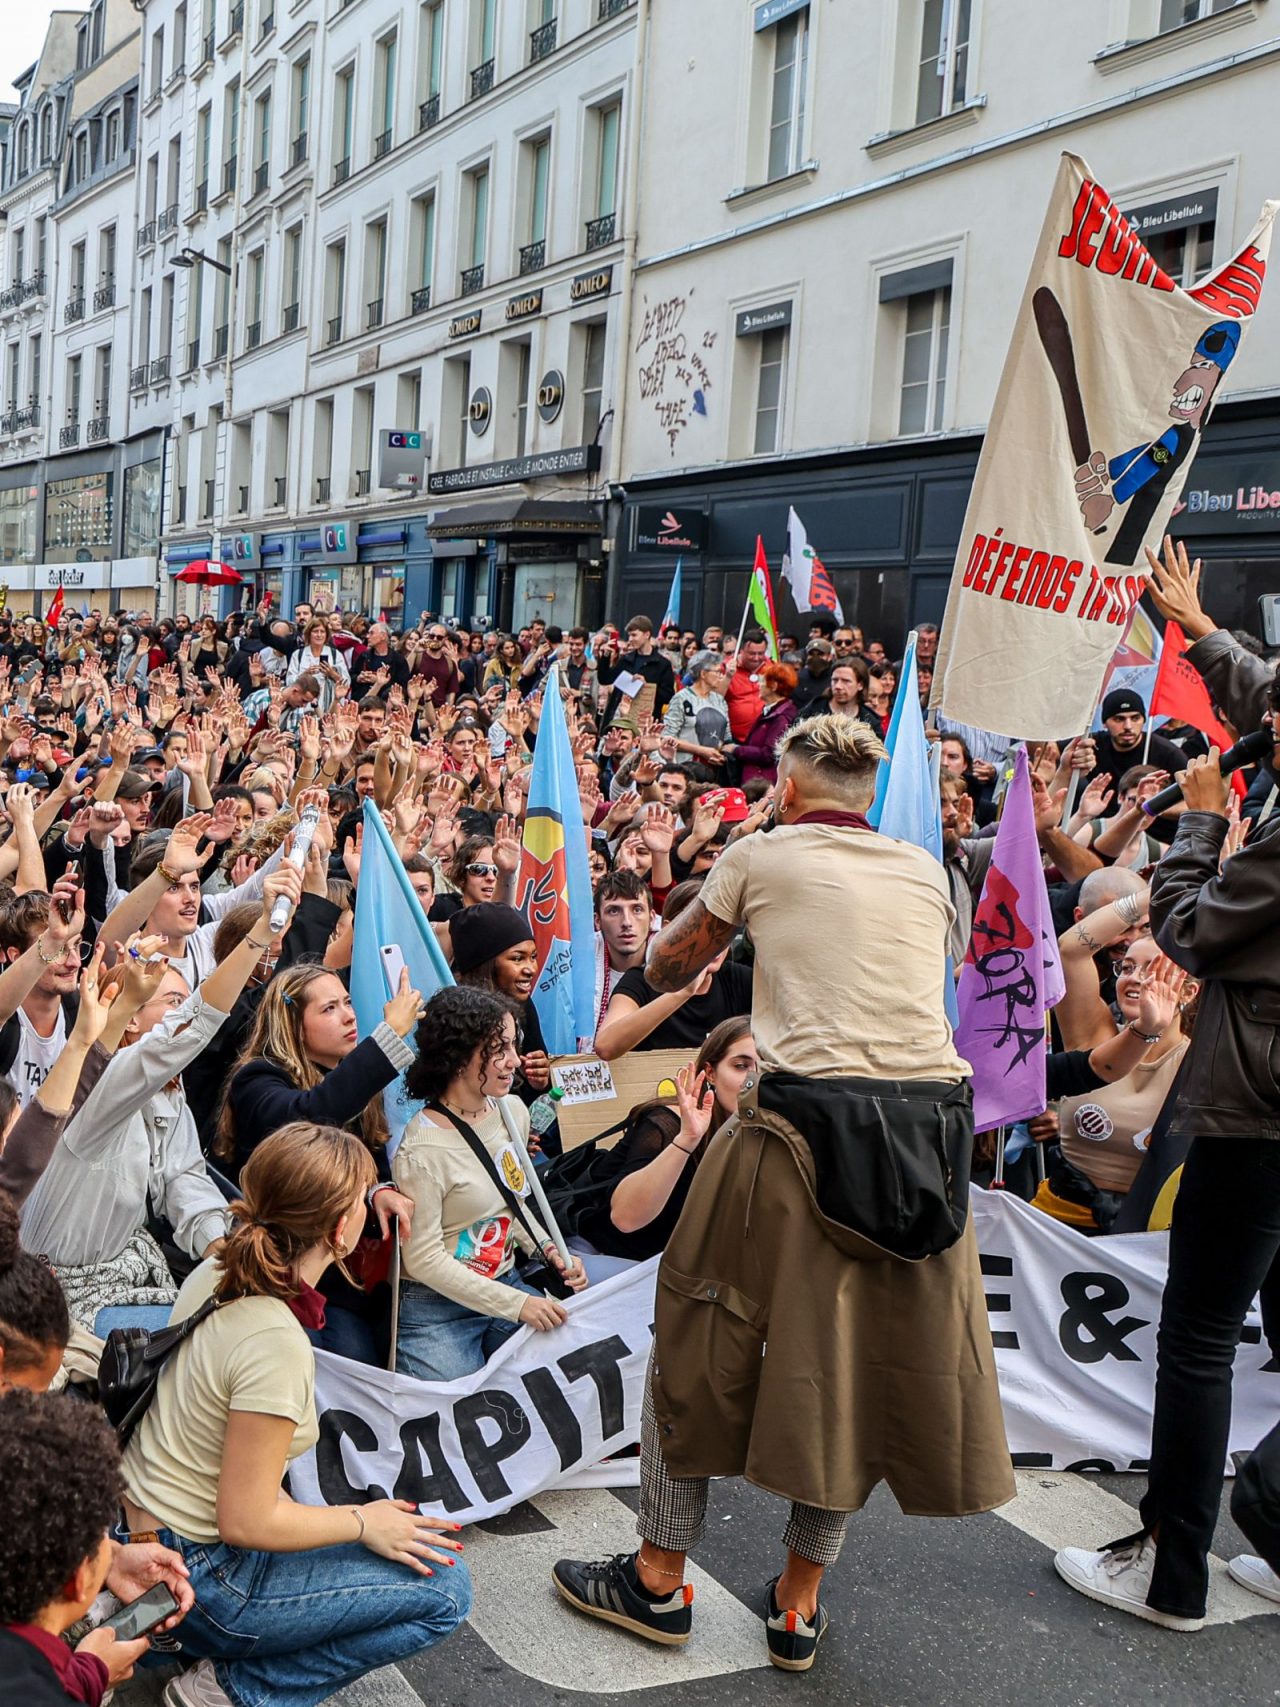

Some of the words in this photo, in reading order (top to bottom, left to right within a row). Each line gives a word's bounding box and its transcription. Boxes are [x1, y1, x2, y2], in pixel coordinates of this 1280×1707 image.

[1143, 212, 1162, 228] Bleu
[1164, 203, 1203, 222] Libellule
[391, 434, 418, 447] CIC
[445, 472, 471, 486] FABRIQUE
[471, 470, 479, 483] ET
[480, 466, 504, 481] INSTALLE
[523, 461, 531, 475] LE
[531, 456, 559, 472] MONDE
[559, 452, 584, 468] ENTIER
[1187, 490, 1233, 513] Bleu
[639, 535, 656, 545] Bleu
[657, 535, 692, 547] Libellule
[963, 527, 1084, 614] DÉFENDS
